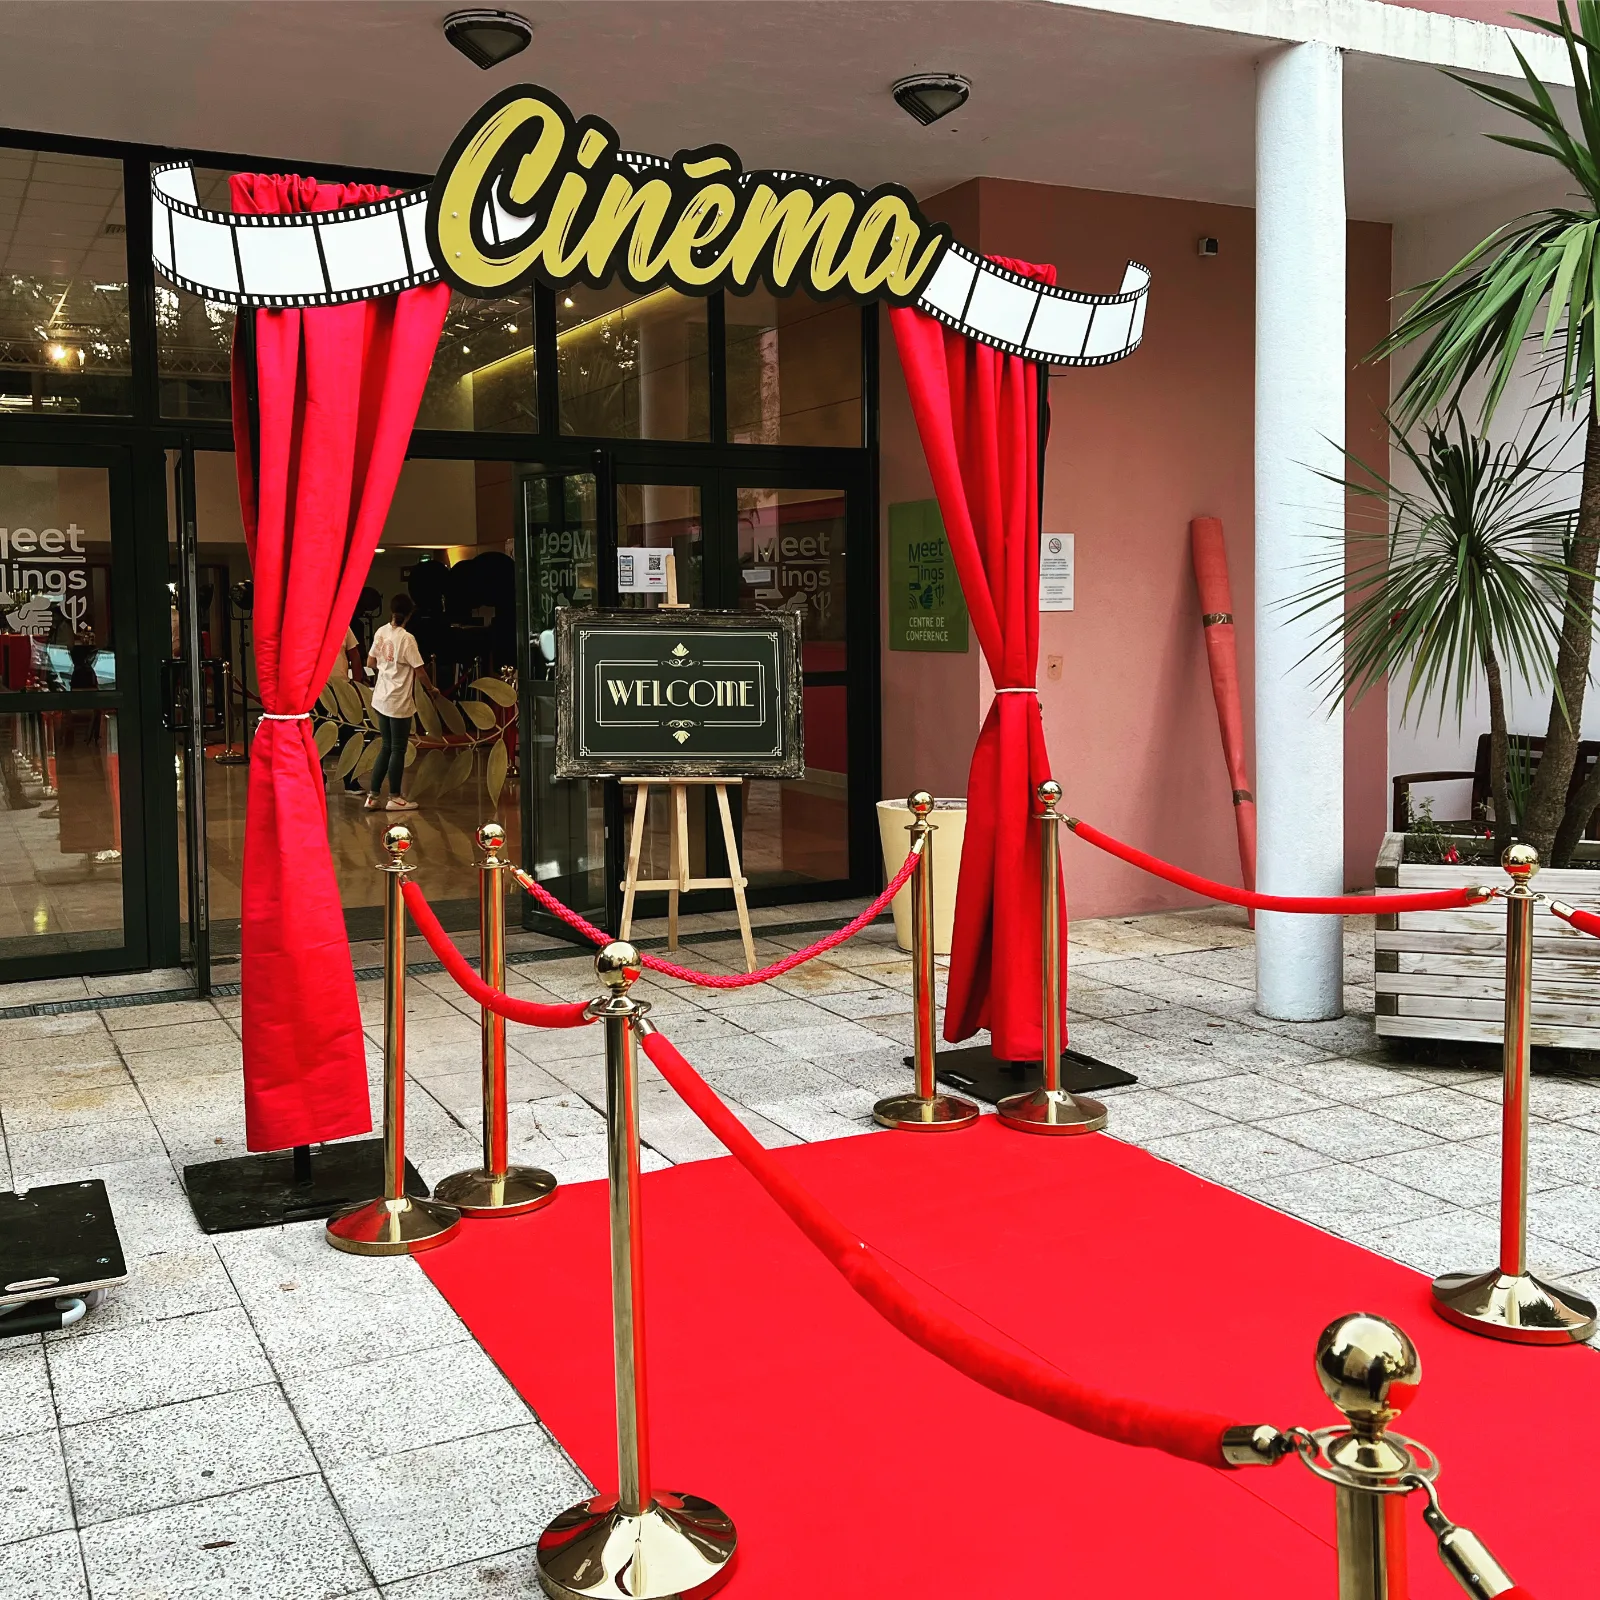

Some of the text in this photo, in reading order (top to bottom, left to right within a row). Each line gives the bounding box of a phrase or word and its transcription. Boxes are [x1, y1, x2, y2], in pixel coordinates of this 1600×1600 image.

[438, 97, 944, 296] Cinéma
[0, 523, 85, 560] eet
[753, 532, 830, 563] Meet
[908, 537, 944, 563] Meet
[906, 629, 949, 642] CONFÉRENCE
[909, 617, 945, 628] CENTRE DE
[606, 679, 755, 707] WELCOME
